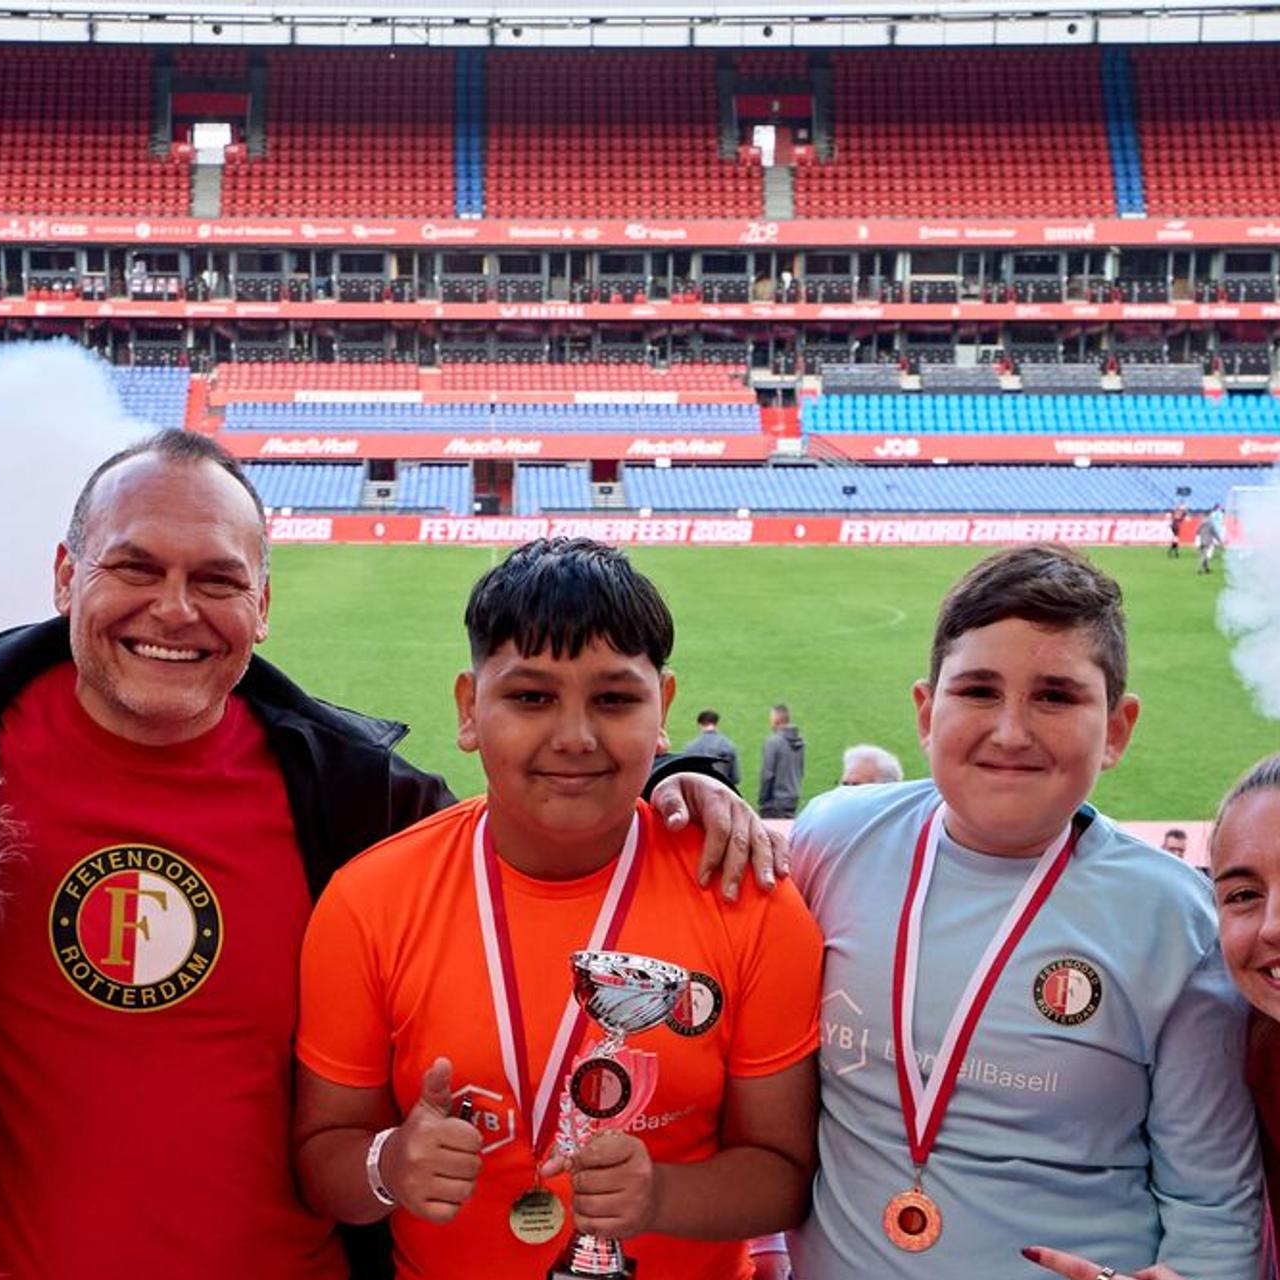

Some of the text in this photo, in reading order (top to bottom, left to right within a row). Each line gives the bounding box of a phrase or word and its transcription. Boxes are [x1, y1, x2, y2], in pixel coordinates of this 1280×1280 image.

[420, 519, 549, 541] FEYENOORD
[839, 520, 971, 541] FEYENOORD
[970, 520, 1115, 541] ZOMERFEEST
[65, 850, 210, 908] FEYENOORD
[61, 945, 208, 1005] ROTTERDAM
[821, 1021, 854, 1049] YB
